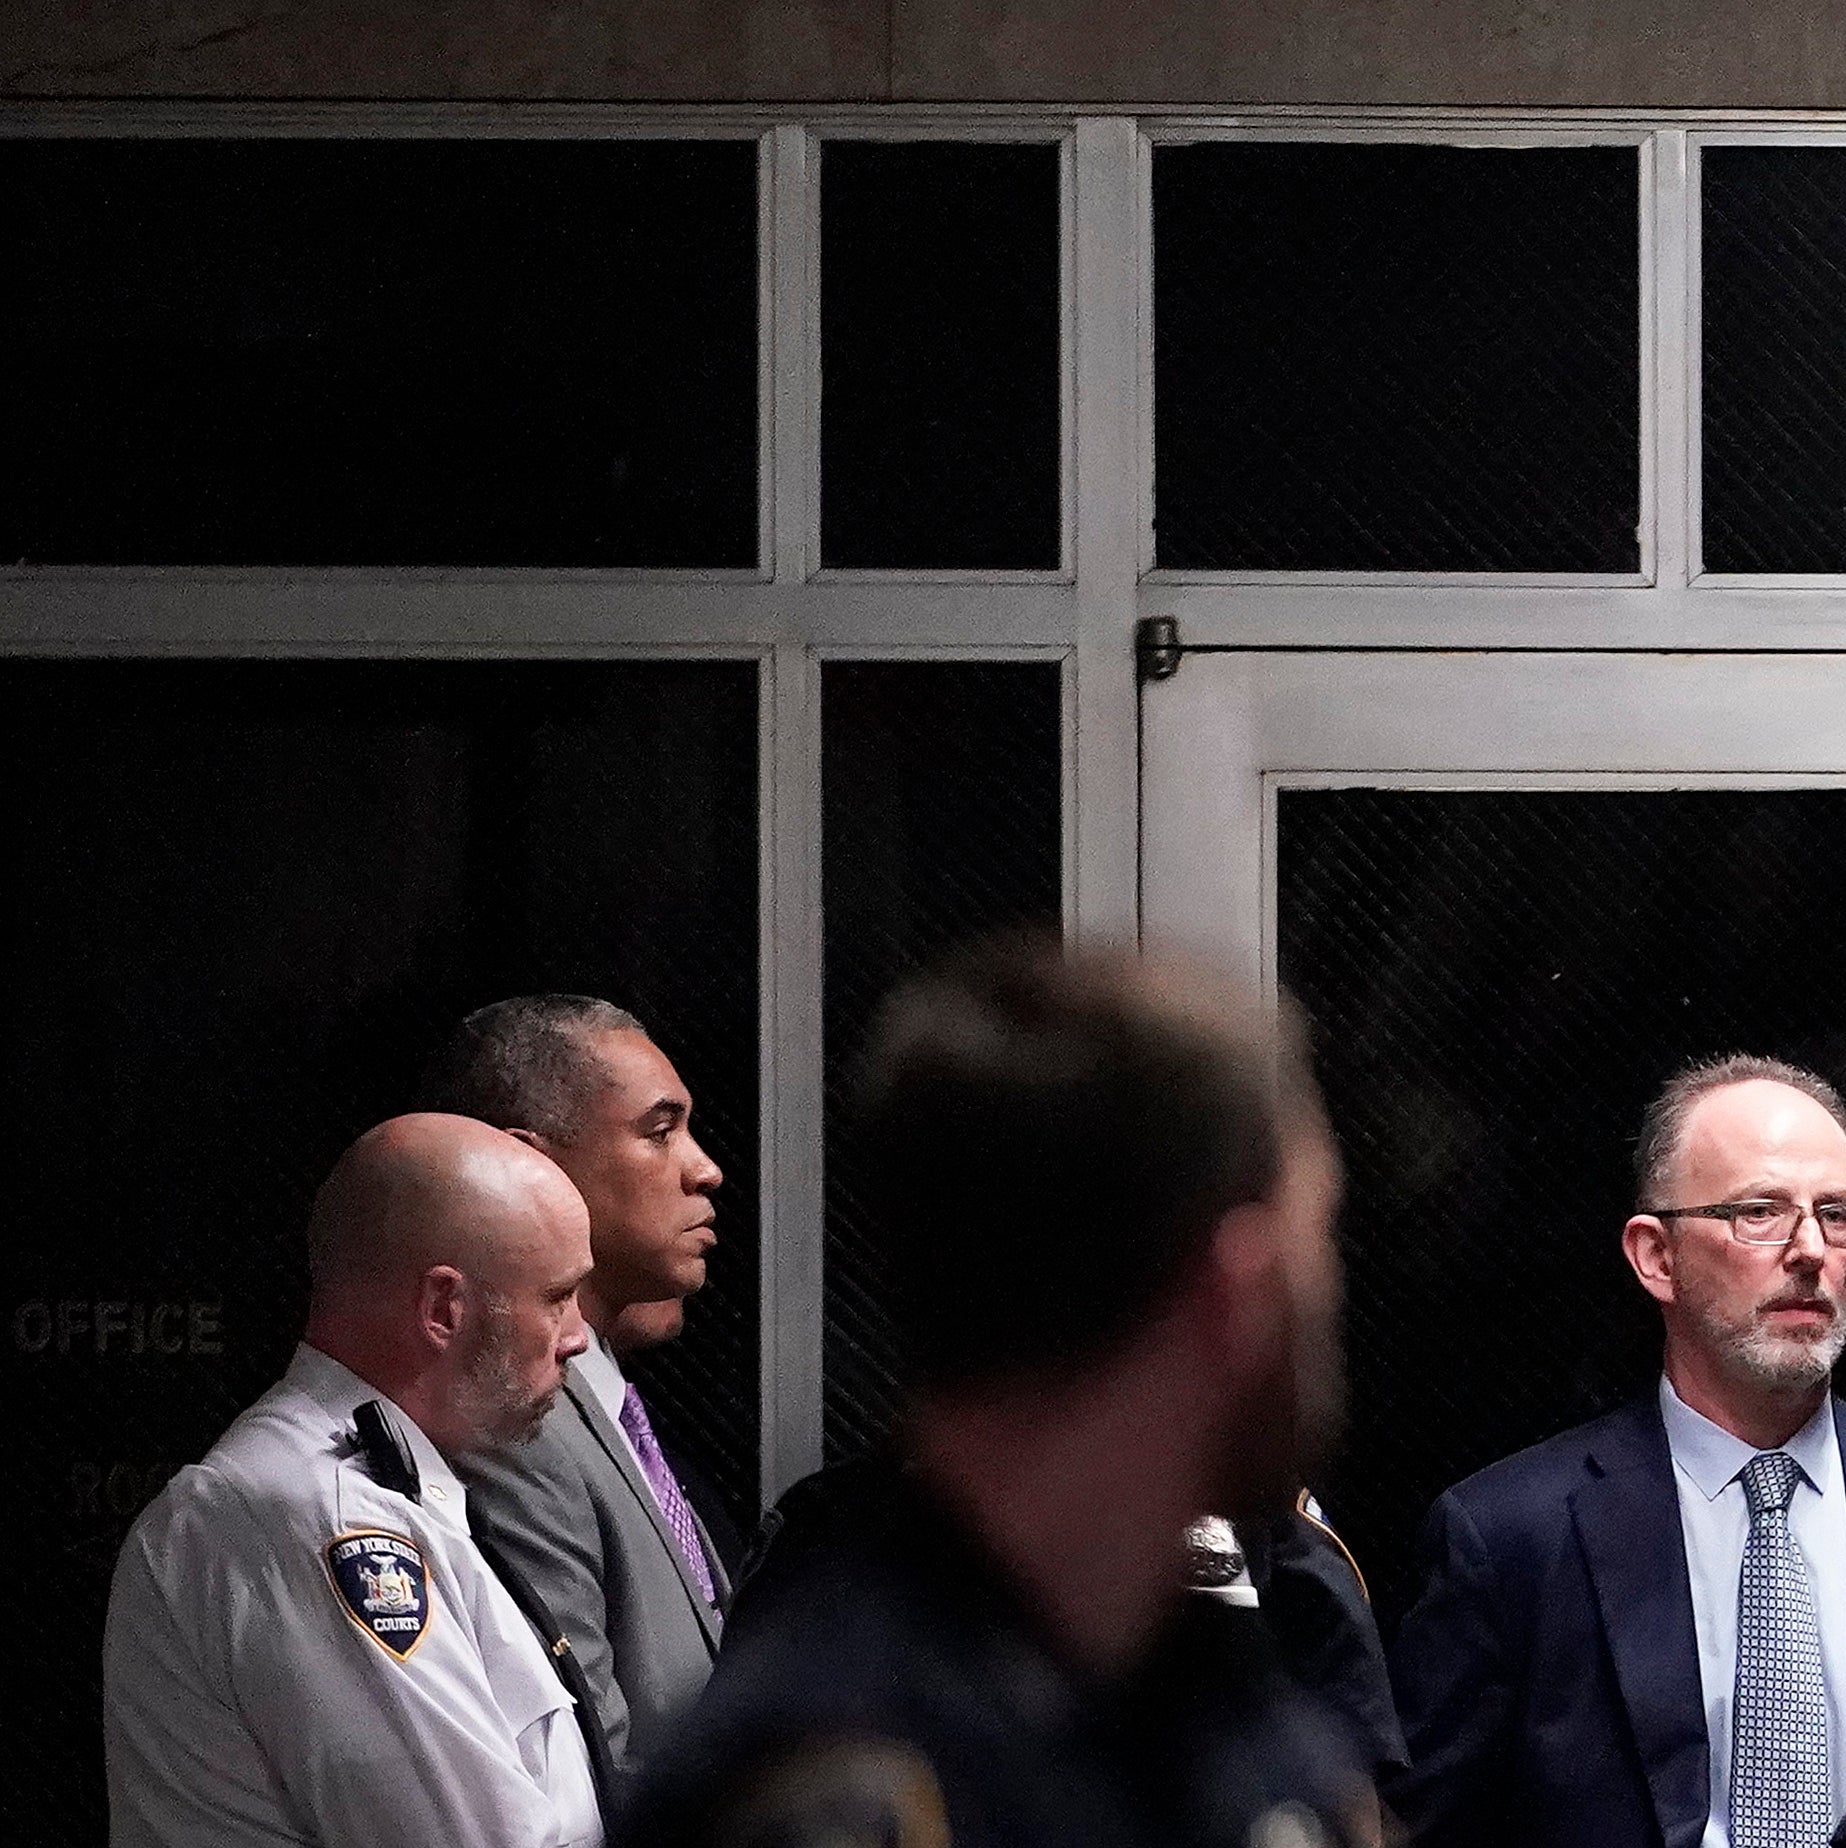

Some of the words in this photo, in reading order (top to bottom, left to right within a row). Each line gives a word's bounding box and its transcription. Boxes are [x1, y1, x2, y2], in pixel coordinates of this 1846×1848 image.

[13, 1299, 226, 1354] OFFICE
[334, 1540, 361, 1564] NEW
[361, 1537, 393, 1554] YORK
[373, 1617, 420, 1632] COURTS
